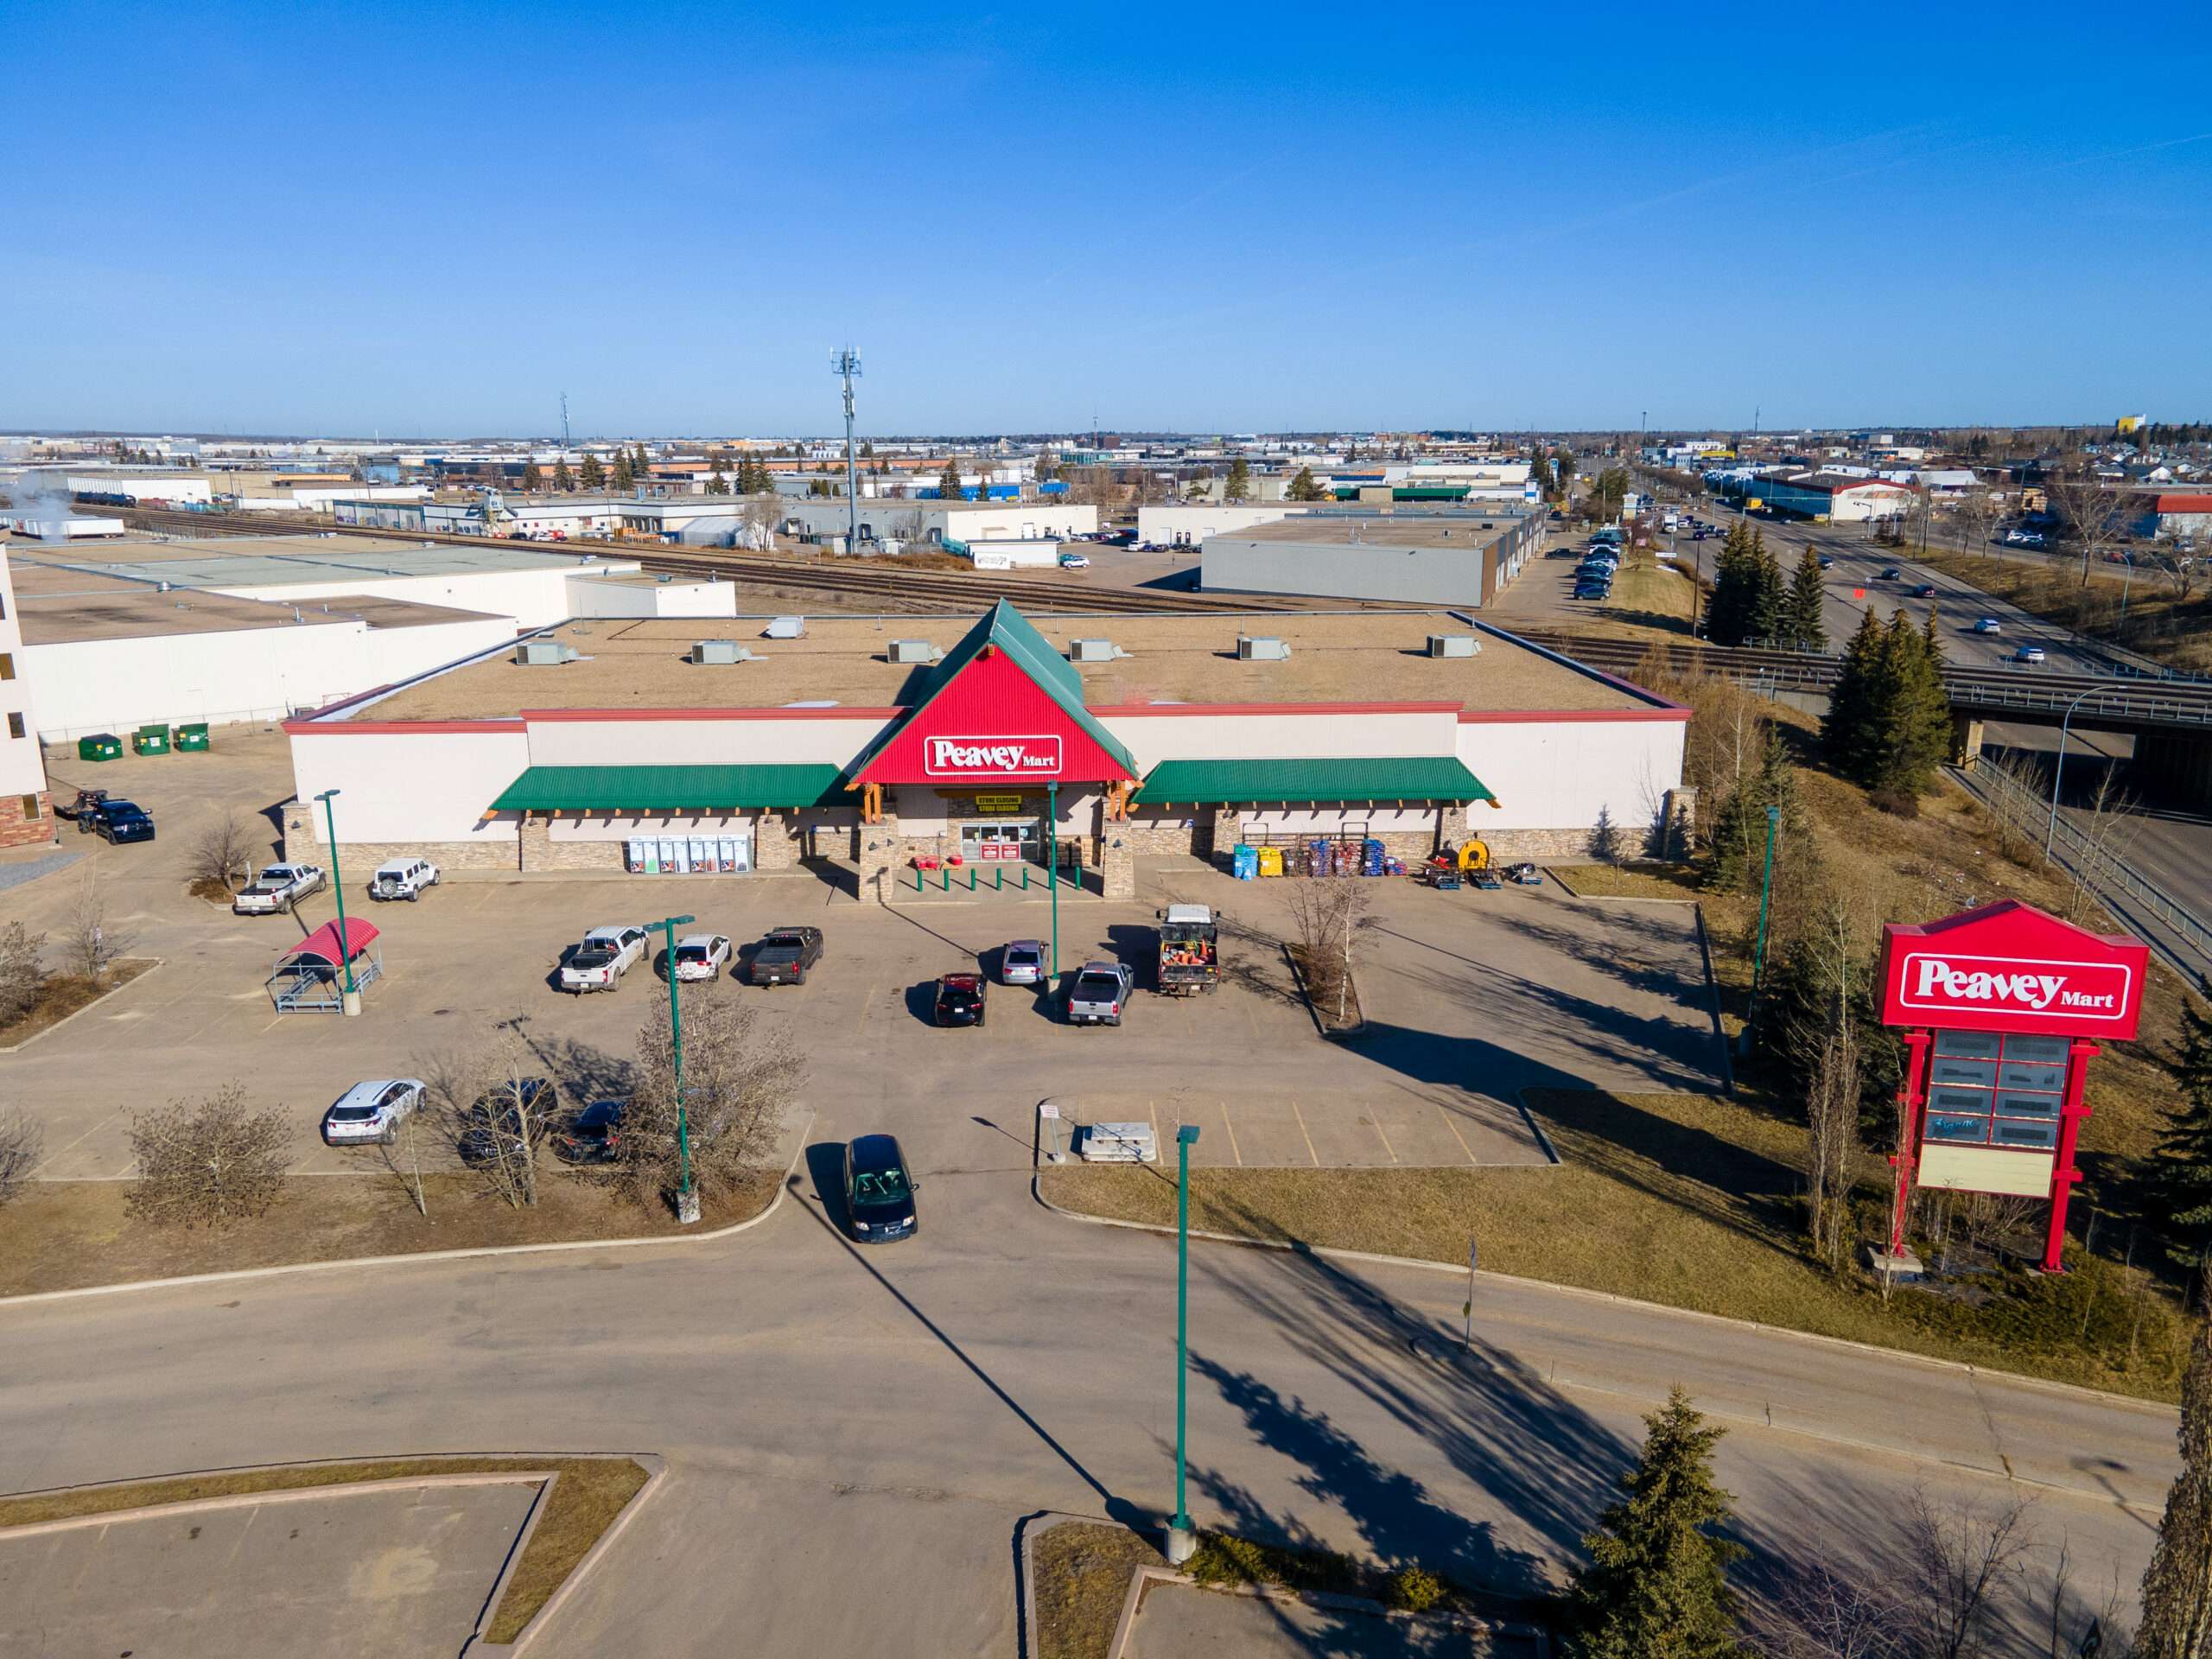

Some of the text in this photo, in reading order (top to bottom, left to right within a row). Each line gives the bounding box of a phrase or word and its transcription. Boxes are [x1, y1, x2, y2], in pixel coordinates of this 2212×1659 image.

[933, 741, 1055, 771] Peavey Mart
[1915, 959, 2115, 1009] Peavey Mart
